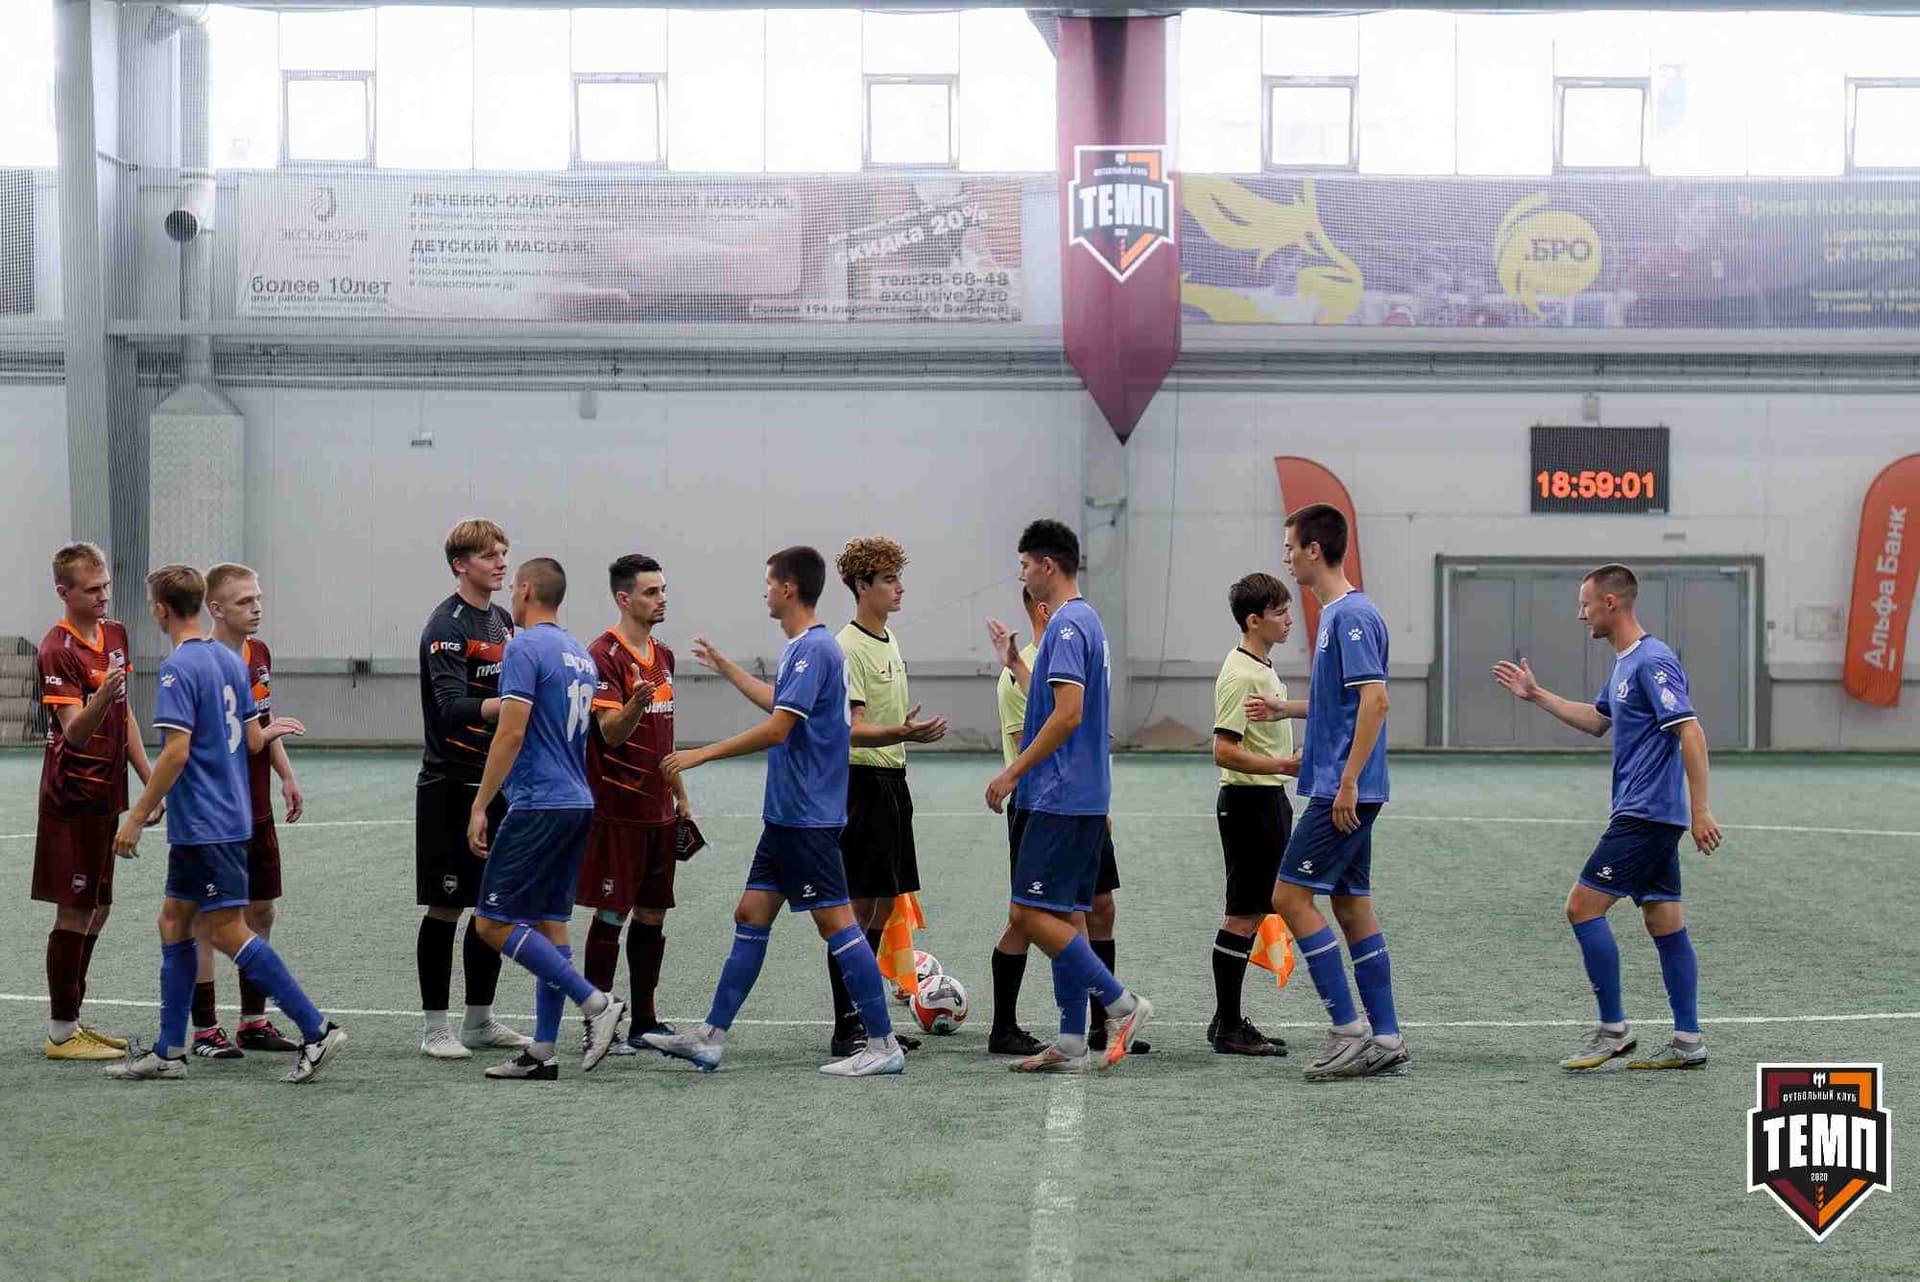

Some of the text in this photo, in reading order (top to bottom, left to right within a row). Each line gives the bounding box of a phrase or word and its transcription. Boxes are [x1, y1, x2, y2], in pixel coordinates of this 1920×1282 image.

[410, 192, 698, 209] ЛЕЧЕБНО-ОЗДОРОВИТЕЛЬНЫЙ
[1079, 183, 1164, 230] ТЕМП
[931, 202, 989, 236] 20%
[410, 236, 498, 254] ДЕТСКИЙ
[251, 275, 391, 295] более 10лет
[1537, 471, 1654, 498] 18:59:01
[1864, 505, 1908, 669] Альфа Банк
[222, 684, 243, 754] 3
